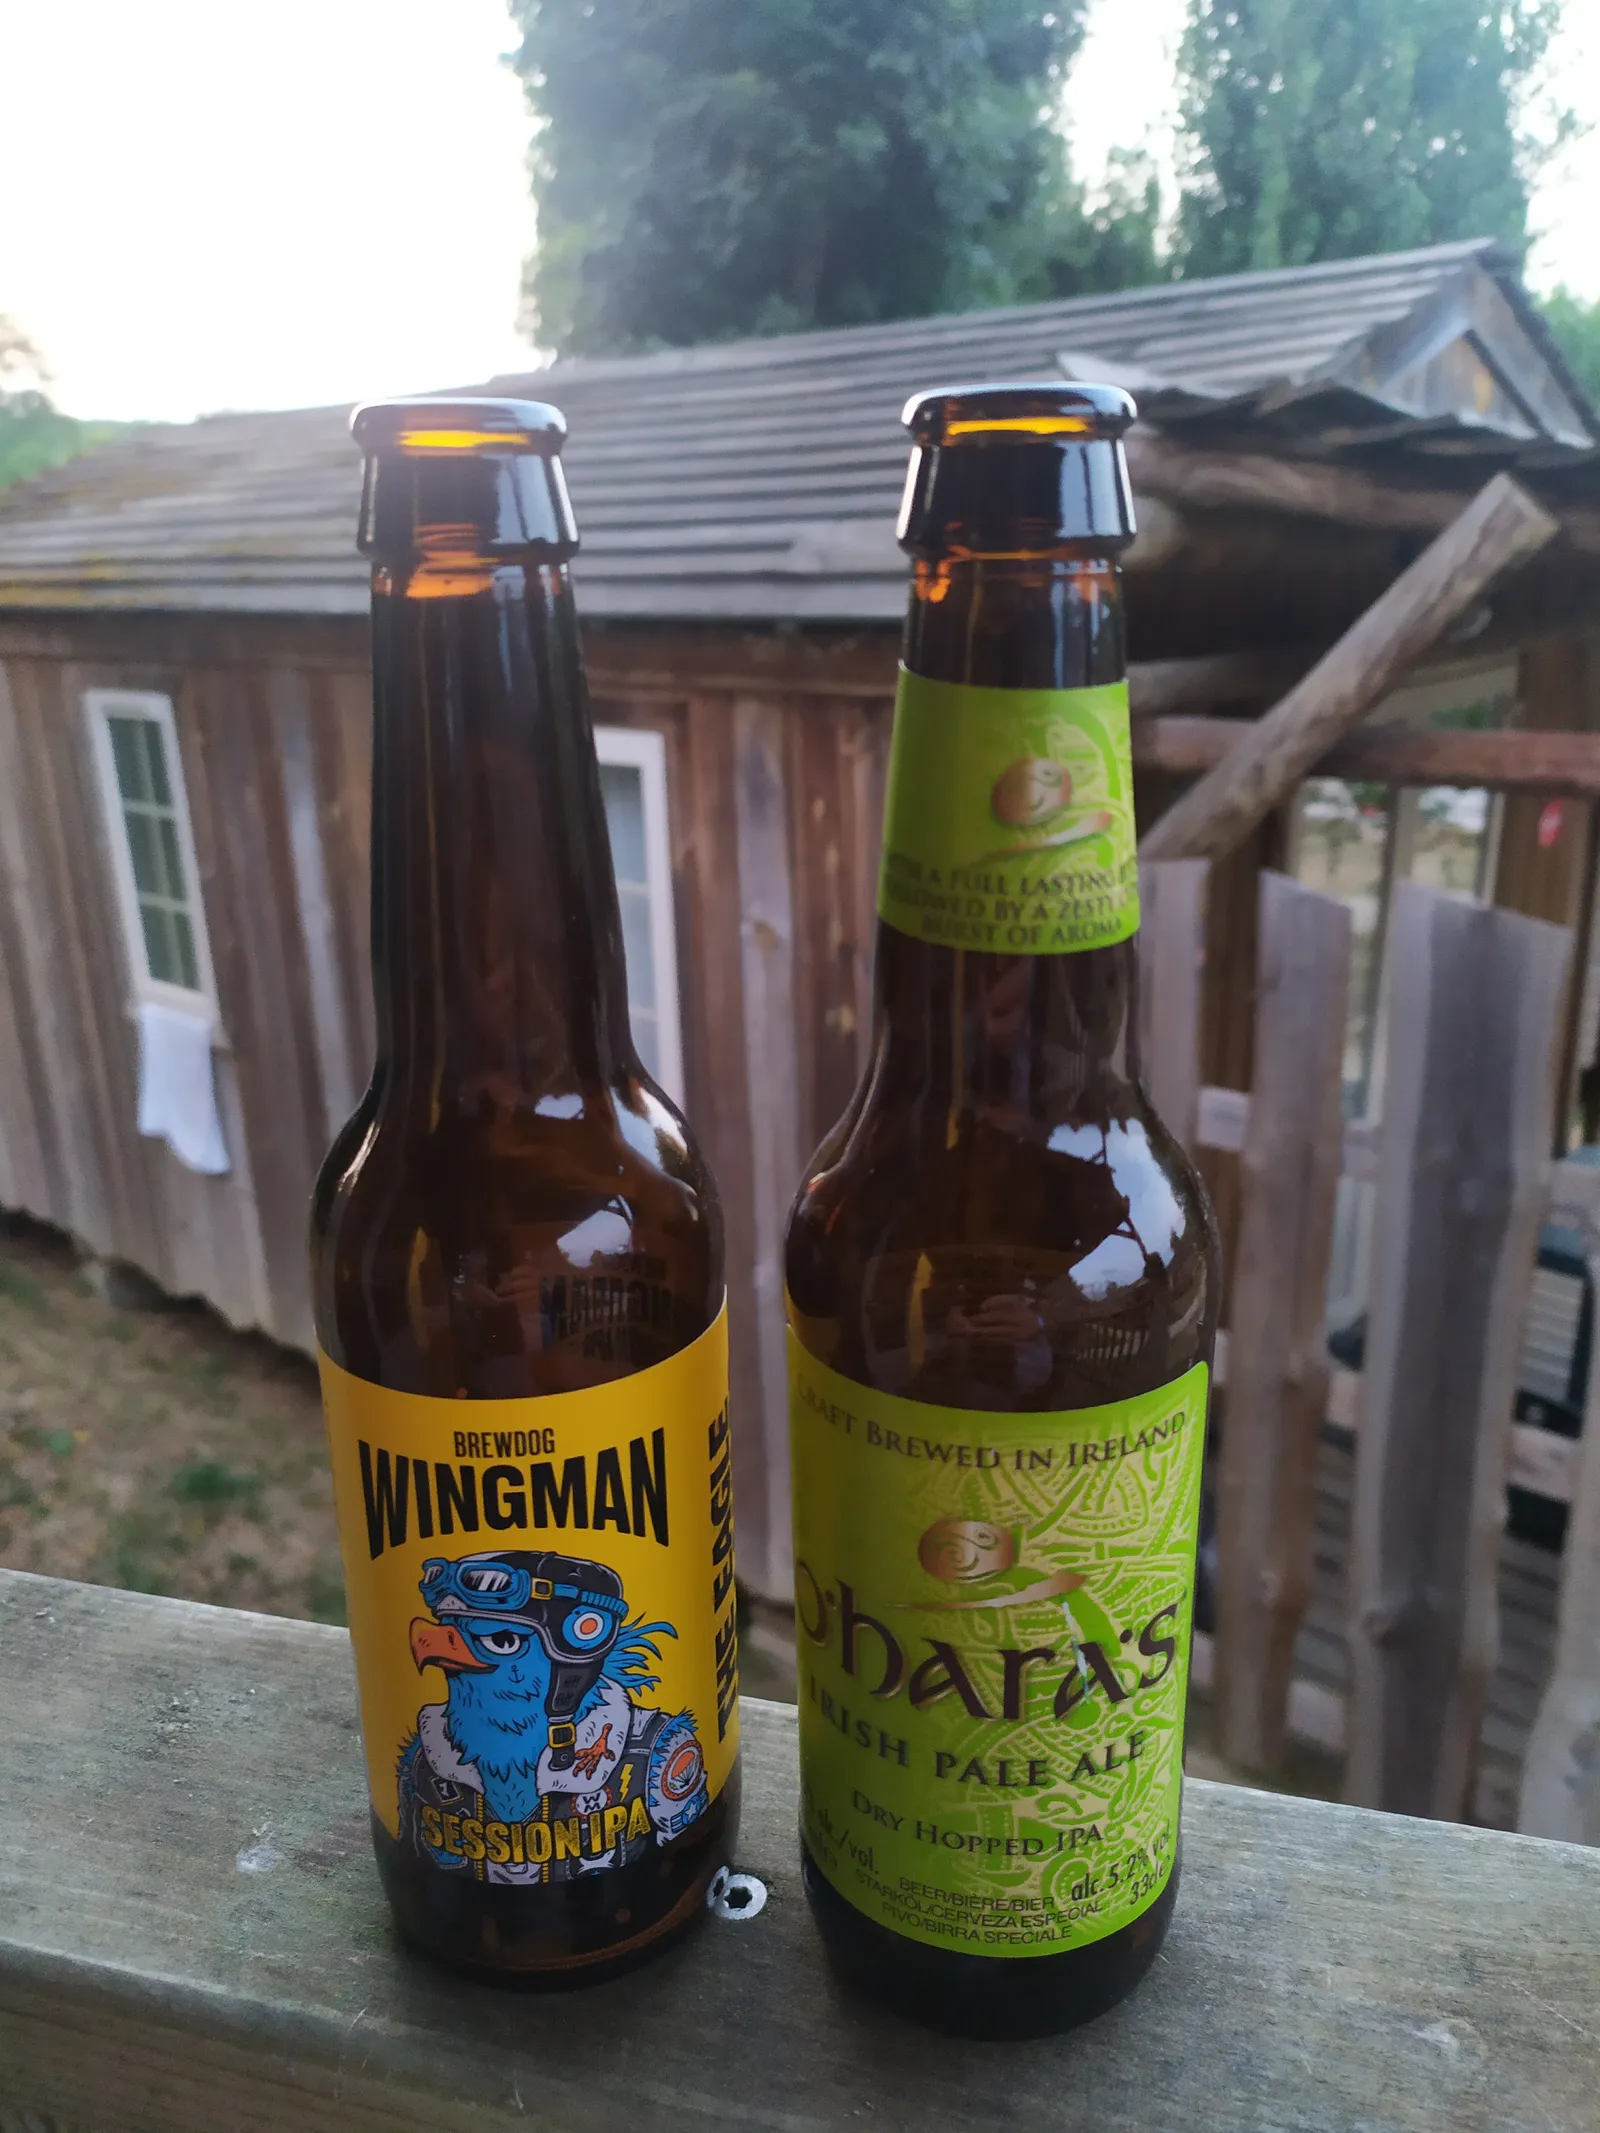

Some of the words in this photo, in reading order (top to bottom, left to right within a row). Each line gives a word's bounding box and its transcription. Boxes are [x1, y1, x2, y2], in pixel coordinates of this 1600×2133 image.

[1020, 870, 1116, 896] LASTING
[1031, 902, 1048, 921] A
[1007, 924, 1041, 946] OF
[453, 1428, 556, 1458] BREWDOG
[866, 1419, 1000, 1470] BREWED
[1014, 1448, 1052, 1470] IN
[1068, 1410, 1187, 1467] IRELAND
[358, 1427, 669, 1561] WINGMAN
[810, 1673, 910, 1768] IRISH
[933, 1750, 1050, 1787] PALE
[1070, 1730, 1146, 1783] ALE
[421, 1805, 581, 1863] SESSION
[589, 1796, 651, 1854] IPA
[852, 1788, 904, 1832] DRY
[915, 1820, 1044, 1856] HOPPED
[1057, 1824, 1104, 1852] IPA
[984, 1925, 1072, 1945] SPECIALE
